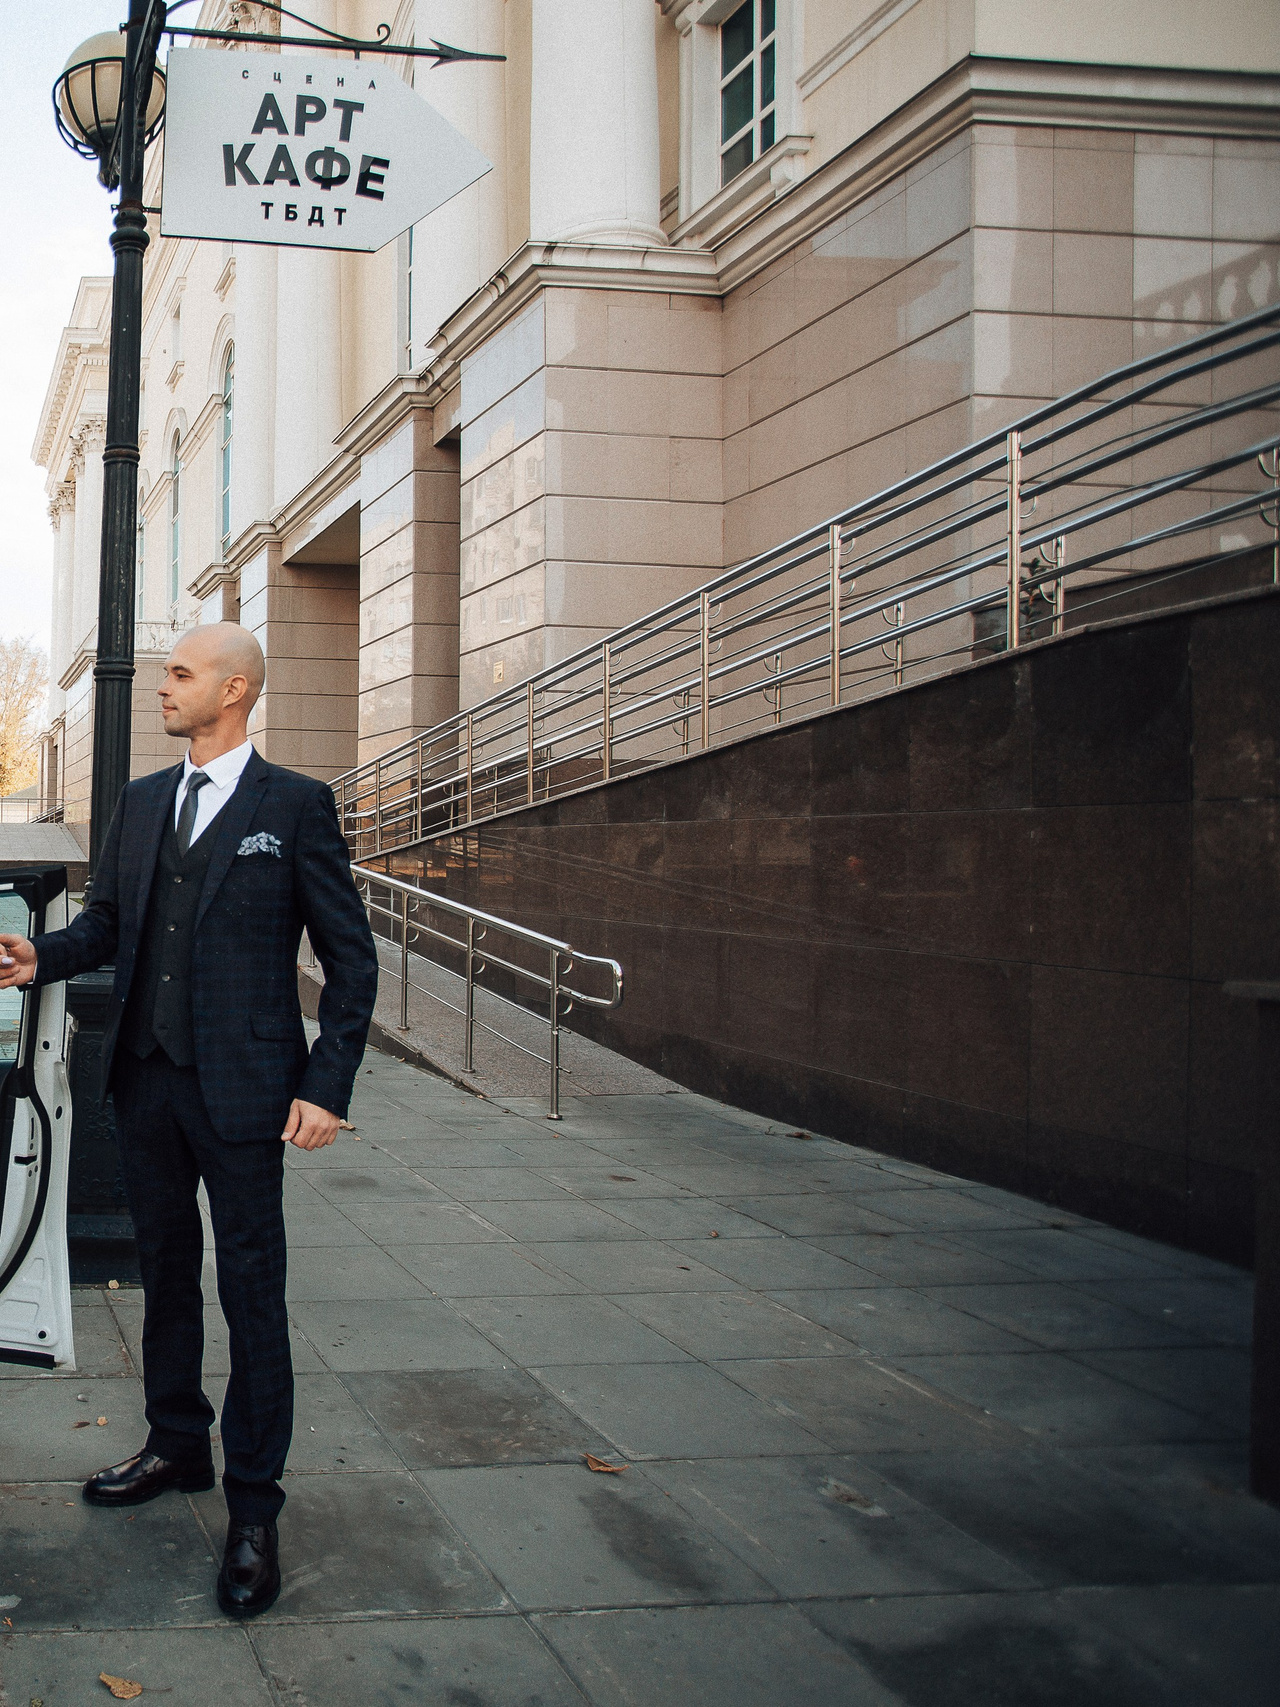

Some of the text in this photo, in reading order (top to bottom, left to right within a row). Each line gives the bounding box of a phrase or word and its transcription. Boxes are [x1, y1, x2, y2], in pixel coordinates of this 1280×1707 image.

[242, 69, 376, 90] СЦЕНА
[251, 92, 365, 143] АРТ
[222, 142, 390, 202] КАФЕ
[260, 201, 347, 228] ТБДТ
